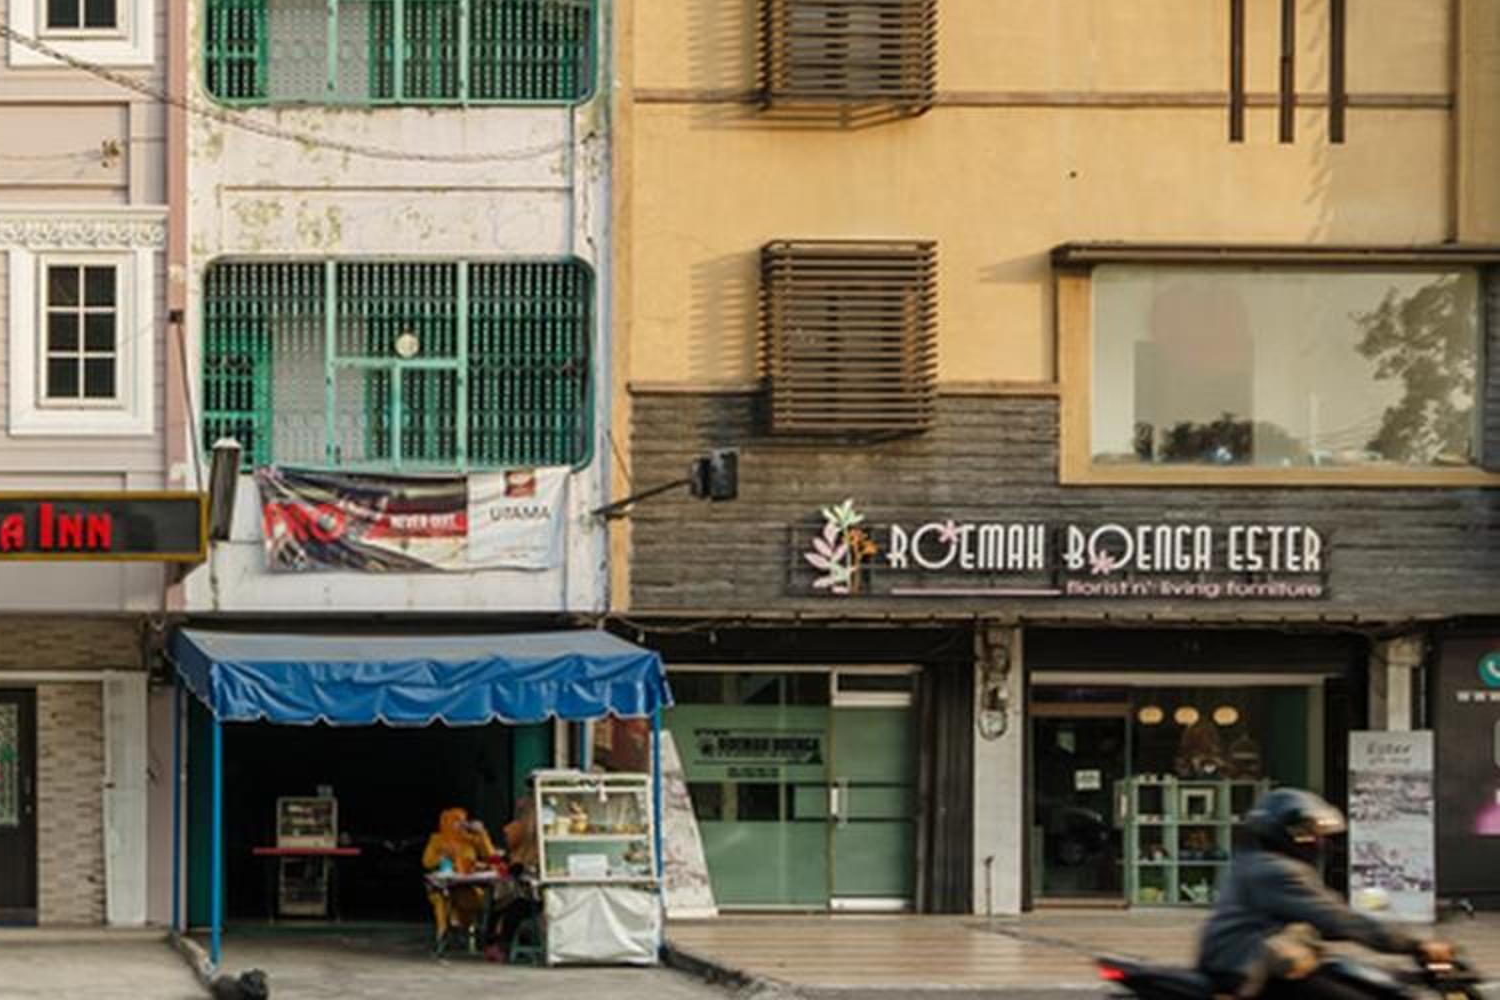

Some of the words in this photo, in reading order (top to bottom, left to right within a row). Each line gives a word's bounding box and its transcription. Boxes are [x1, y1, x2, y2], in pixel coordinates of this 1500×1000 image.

[39, 502, 112, 550] INN
[886, 521, 1045, 569] ROEMAH
[1062, 523, 1212, 572] BOENGA
[1228, 525, 1321, 571] ESTER
[1160, 579, 1220, 598] living
